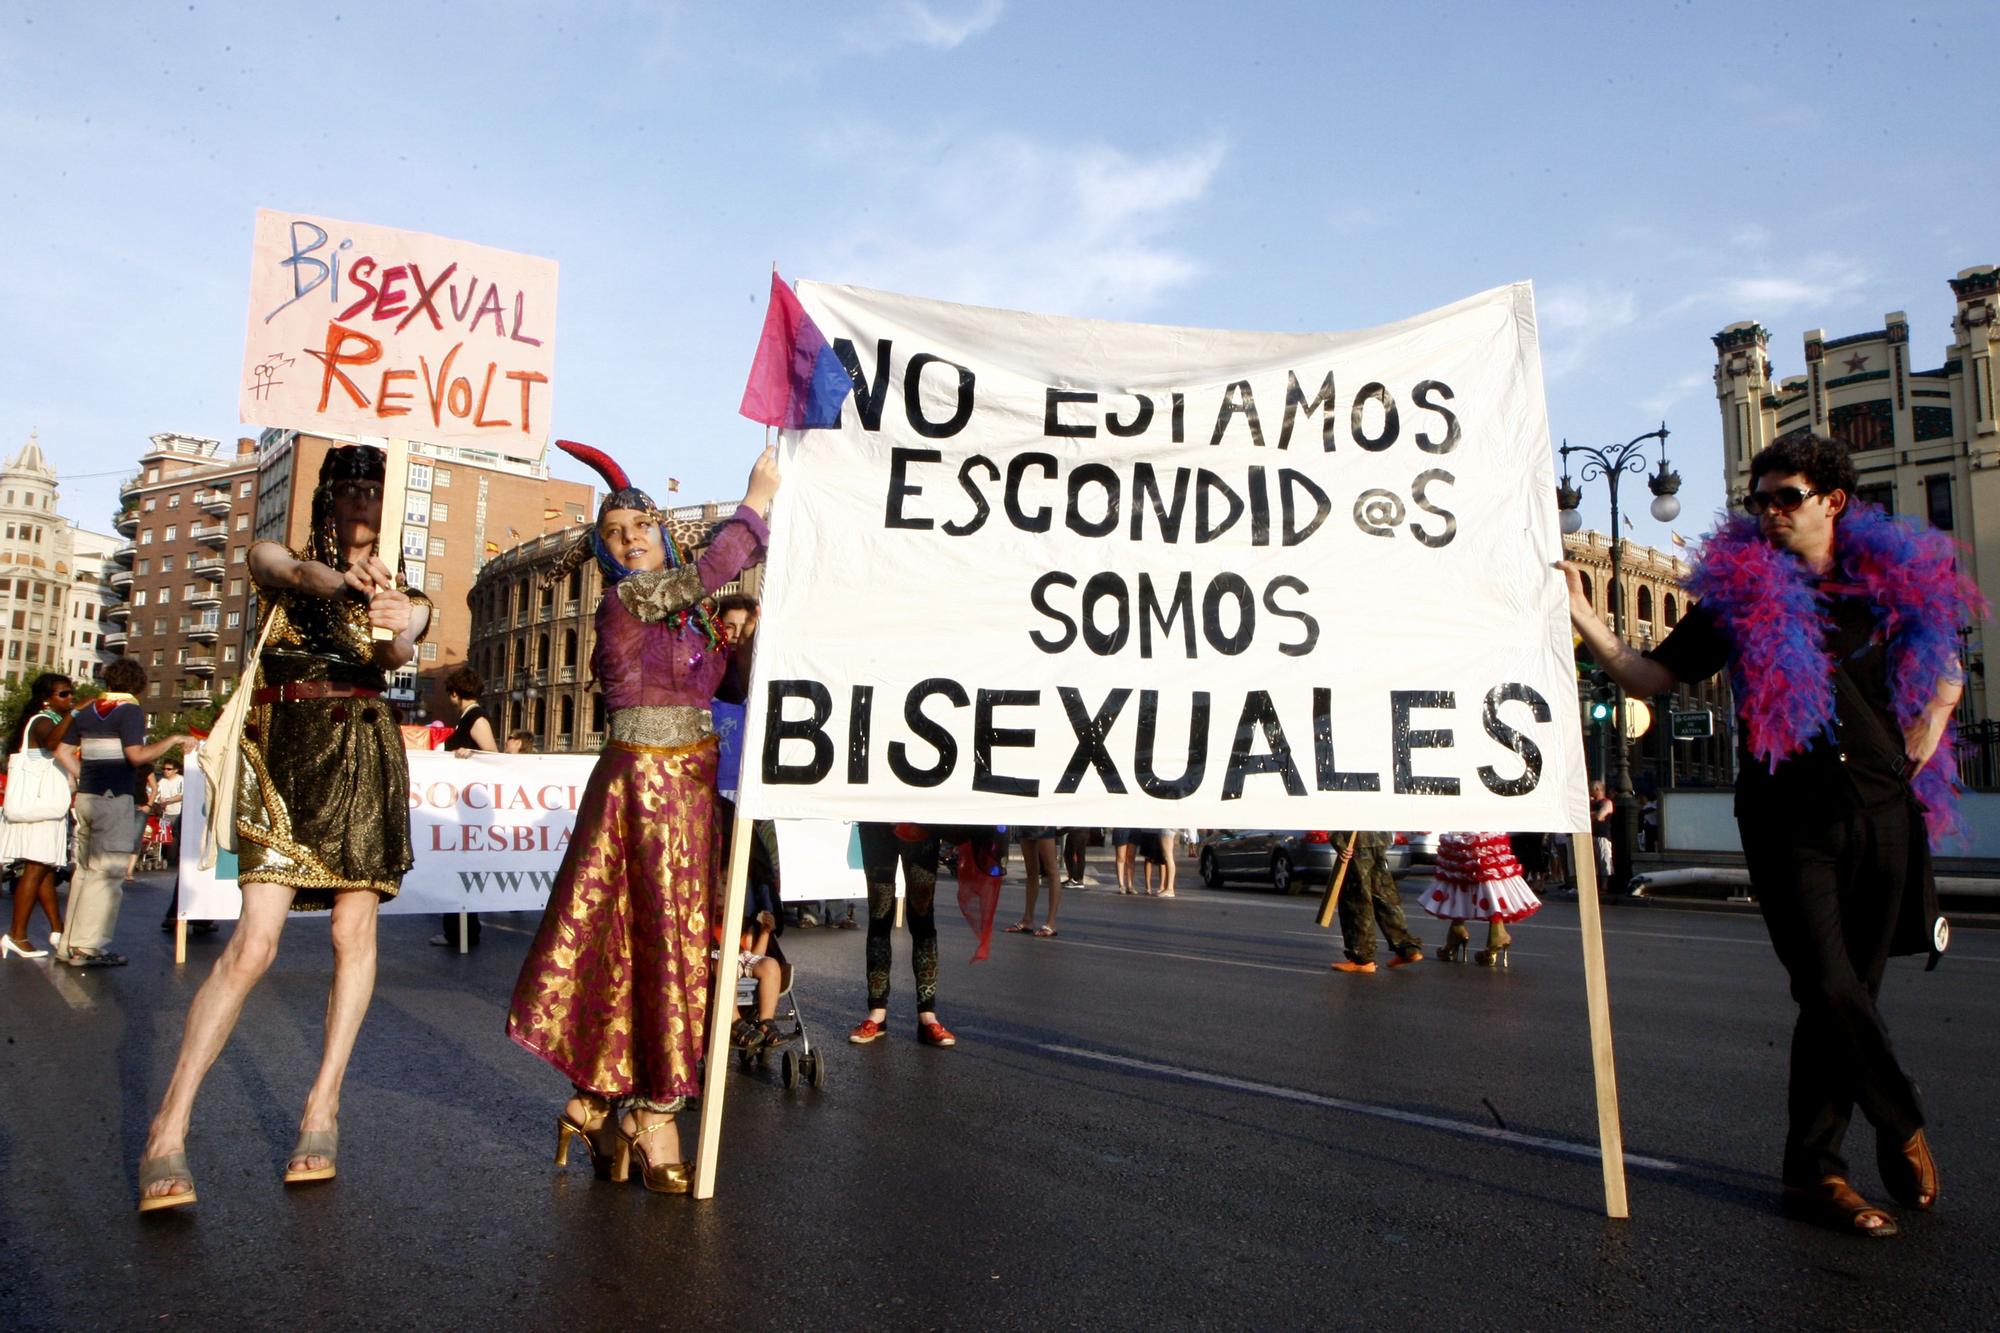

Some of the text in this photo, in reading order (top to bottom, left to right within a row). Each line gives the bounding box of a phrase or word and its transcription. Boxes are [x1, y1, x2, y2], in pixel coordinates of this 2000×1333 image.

[832, 337, 976, 439] NO
[1029, 571, 1320, 658] SOMOS
[762, 677, 1552, 801] BISEXUALES
